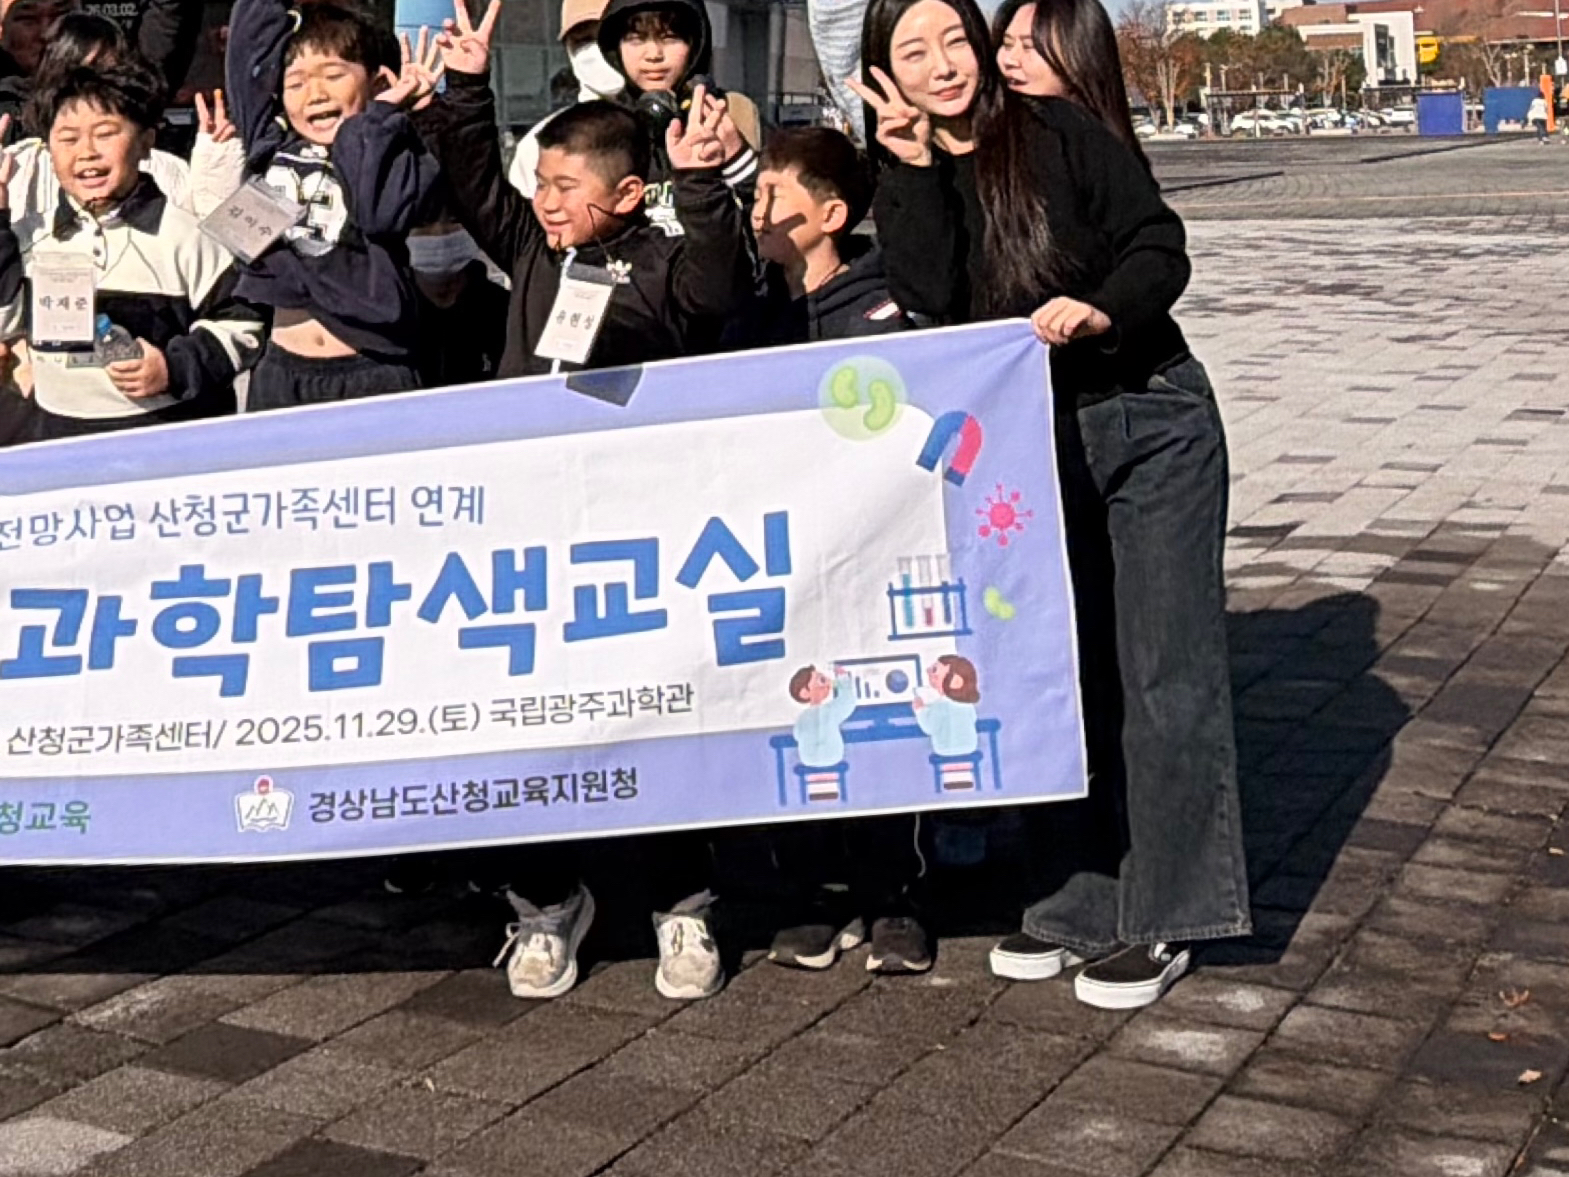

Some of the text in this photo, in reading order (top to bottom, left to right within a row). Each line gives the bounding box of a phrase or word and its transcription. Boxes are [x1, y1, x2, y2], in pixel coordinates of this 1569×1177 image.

[149, 486, 397, 538] 산청군가족센터
[411, 484, 485, 527] 연계
[235, 702, 482, 747] 2025.11.29.(토)
[488, 682, 695, 727] 국립광주과학관
[308, 766, 639, 824] 경상남도산청교육지원청
